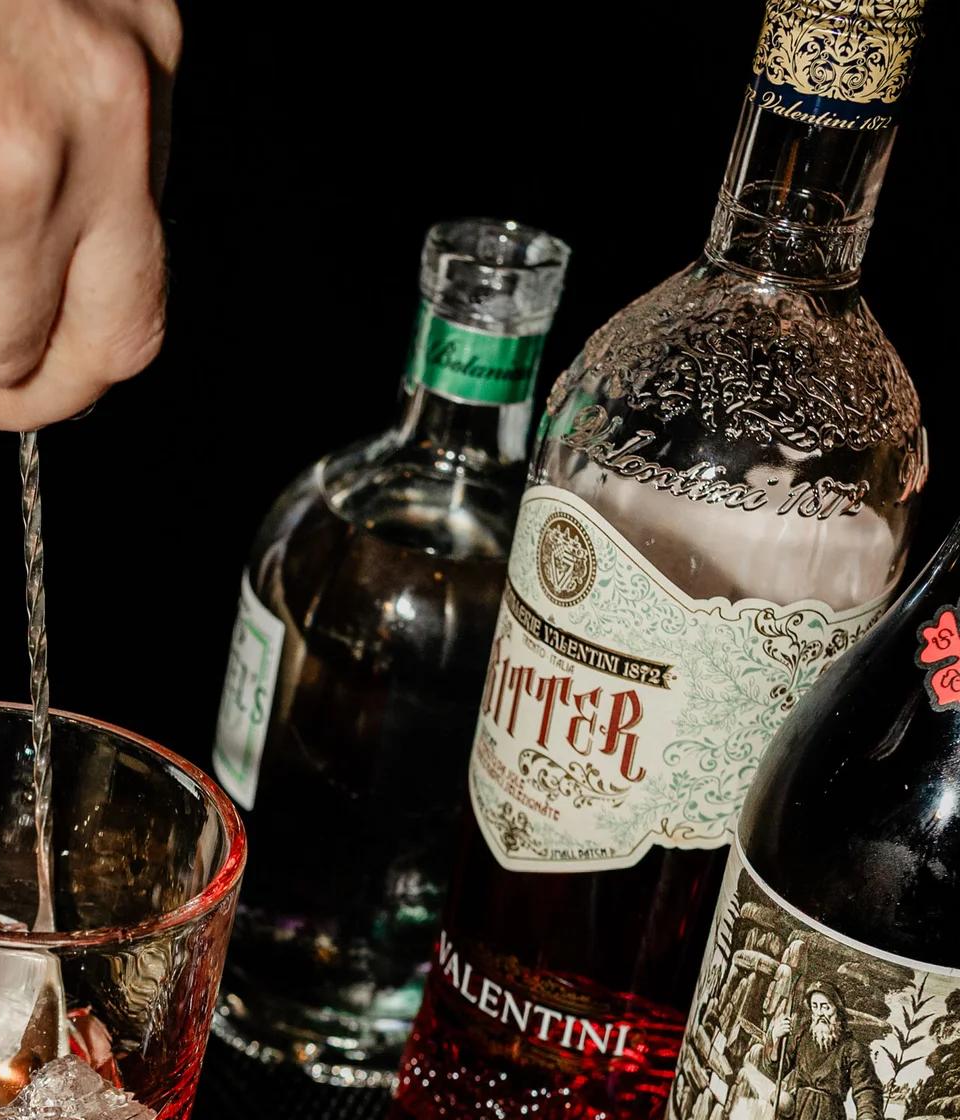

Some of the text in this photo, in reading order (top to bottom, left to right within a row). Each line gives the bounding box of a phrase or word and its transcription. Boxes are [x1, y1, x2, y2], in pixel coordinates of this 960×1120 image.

[758, 91, 860, 129] Valentini
[859, 115, 892, 131] 1872
[561, 405, 871, 520] Valentini 1872
[543, 625, 622, 674] VALENTINI
[621, 661, 664, 685] 1872
[549, 655, 575, 675] ITALIA
[438, 929, 631, 1057] VALENTINI
